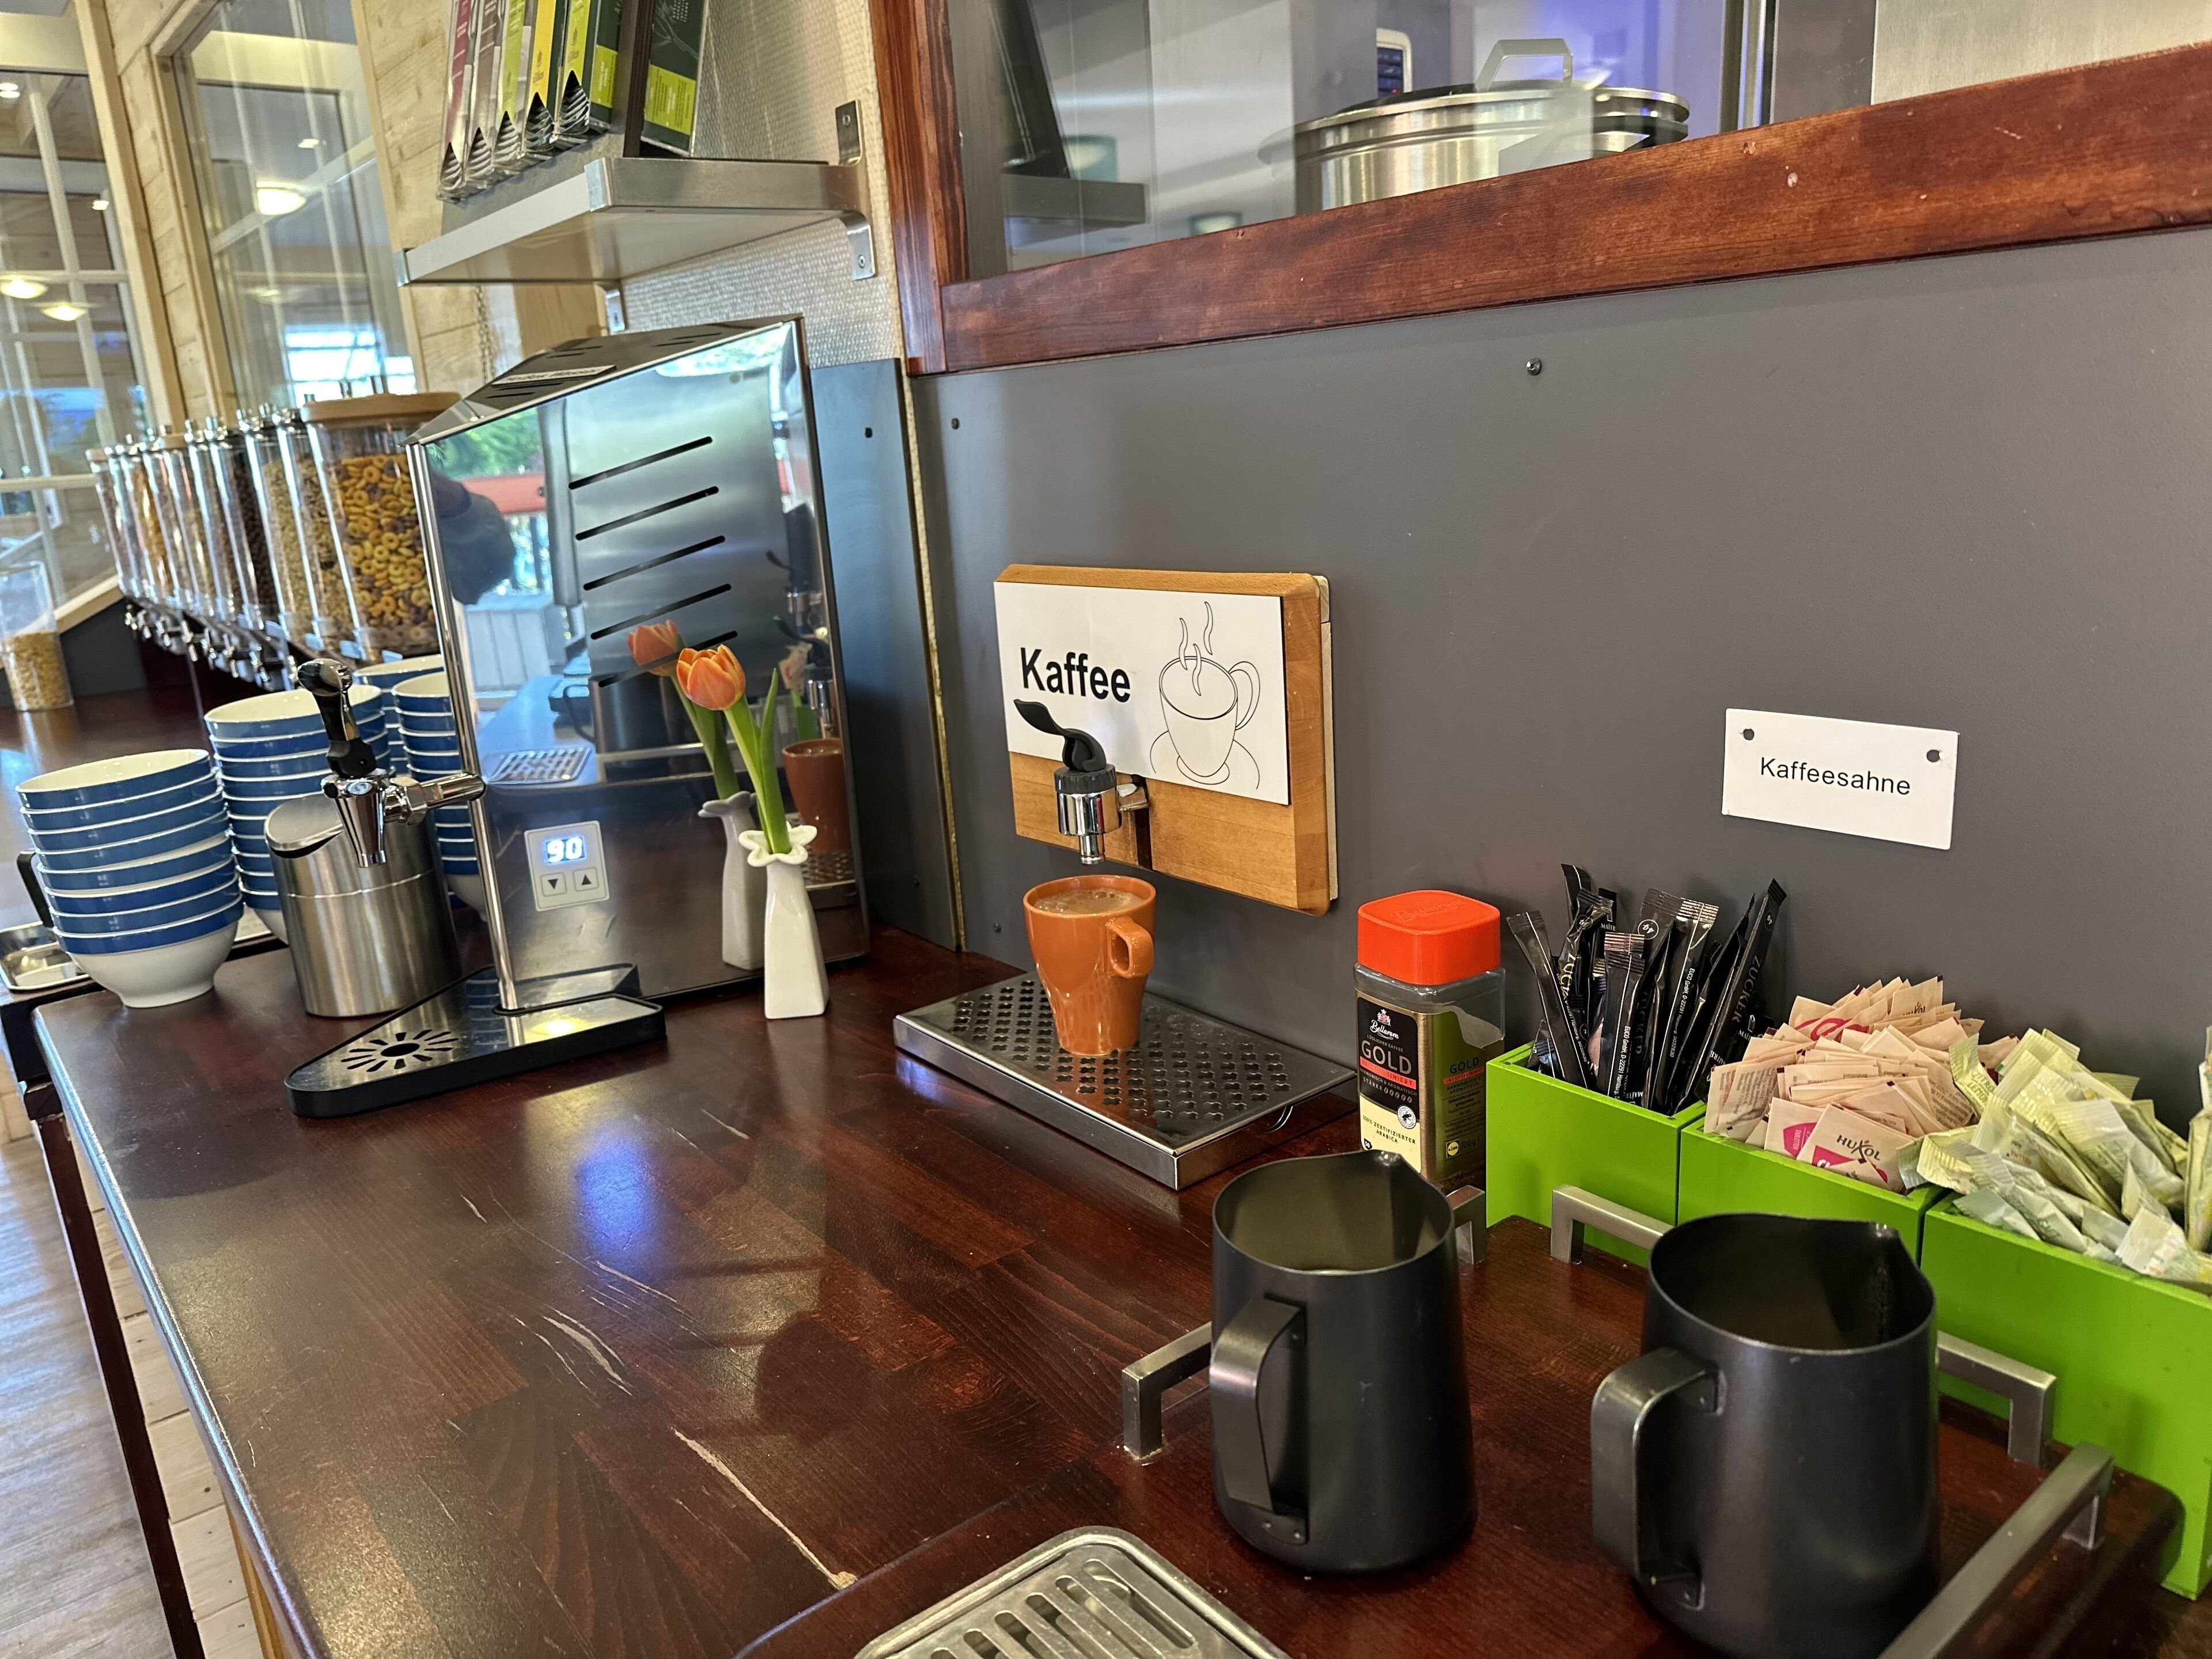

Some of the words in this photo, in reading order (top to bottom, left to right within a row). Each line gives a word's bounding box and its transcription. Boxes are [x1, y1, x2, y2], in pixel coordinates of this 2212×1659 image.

[1020, 647, 1131, 703] Kaffee
[1761, 757, 1911, 795] Kaffeesahne
[547, 837, 582, 863] 90
[1600, 923, 1616, 931] MAÎTR
[1731, 954, 1762, 1023] ZUCKER
[1370, 1019, 1399, 1040] Bellarom
[1623, 1025, 1631, 1039] EUCO
[1361, 1040, 1412, 1075] GOLD
[1450, 1057, 1479, 1074] GOLD
[1618, 1054, 1627, 1073] D-22291
[1363, 1077, 1382, 1090] STÄRKE
[1970, 1071, 1995, 1093] ZITRO
[1374, 1122, 1416, 1144] ZERTIFIZIERTER
[1376, 1130, 1398, 1143] ARABICA
